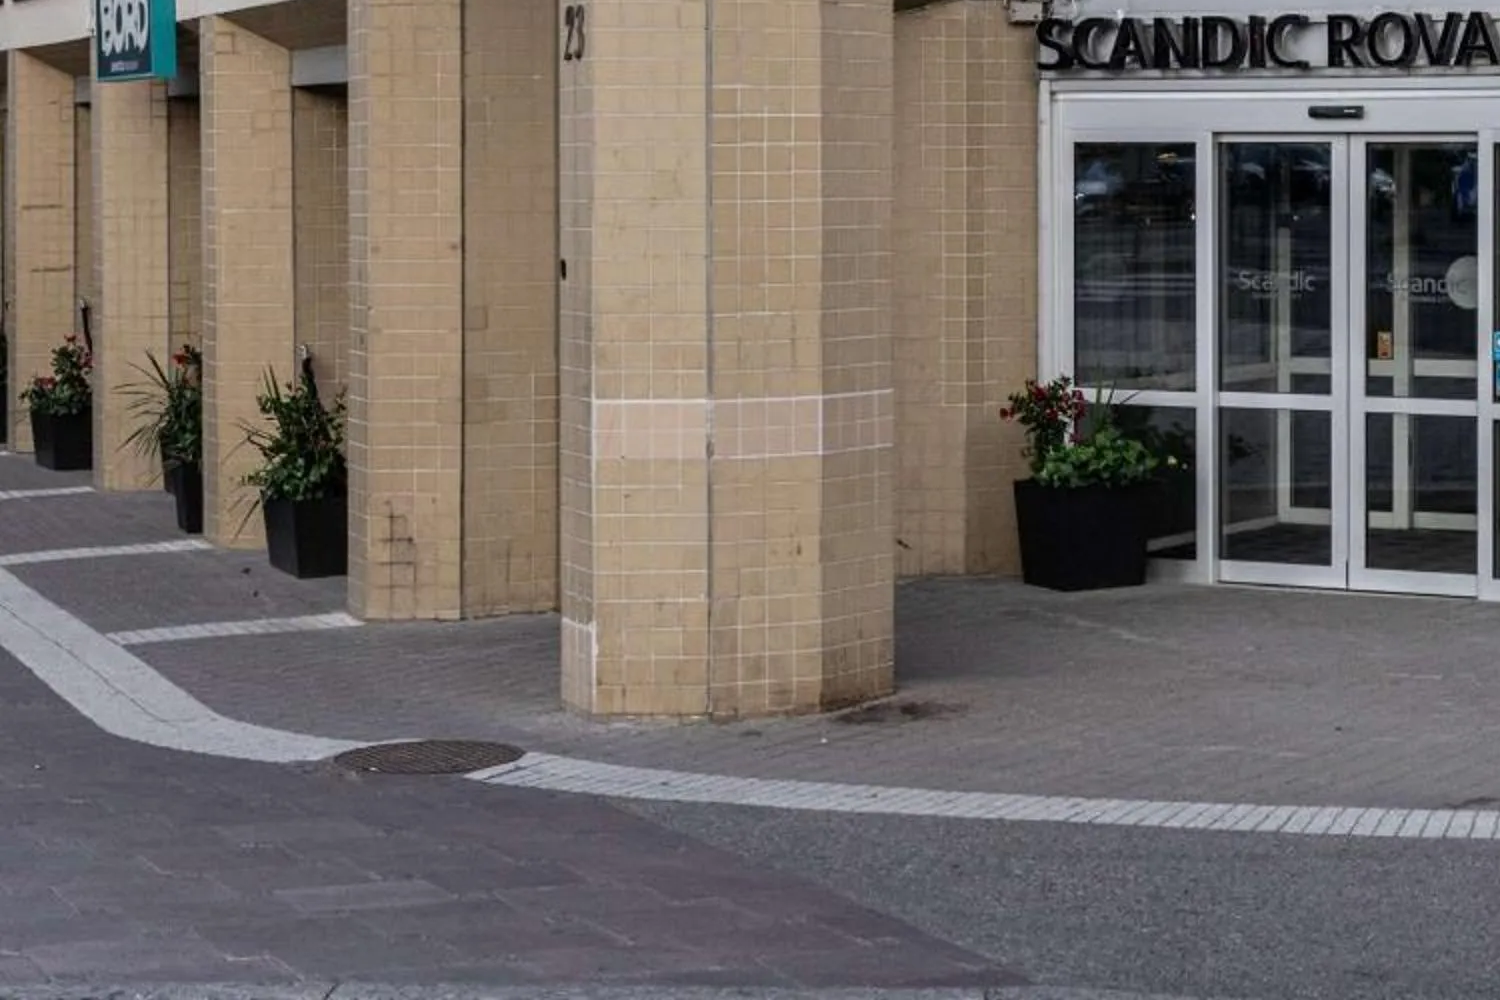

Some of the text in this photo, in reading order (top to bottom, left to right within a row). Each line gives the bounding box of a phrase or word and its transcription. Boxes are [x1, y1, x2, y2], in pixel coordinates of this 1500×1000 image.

[564, 4, 585, 61] 23
[1037, 13, 1311, 71] SCANDIC
[1238, 269, 1318, 292] Scadic
